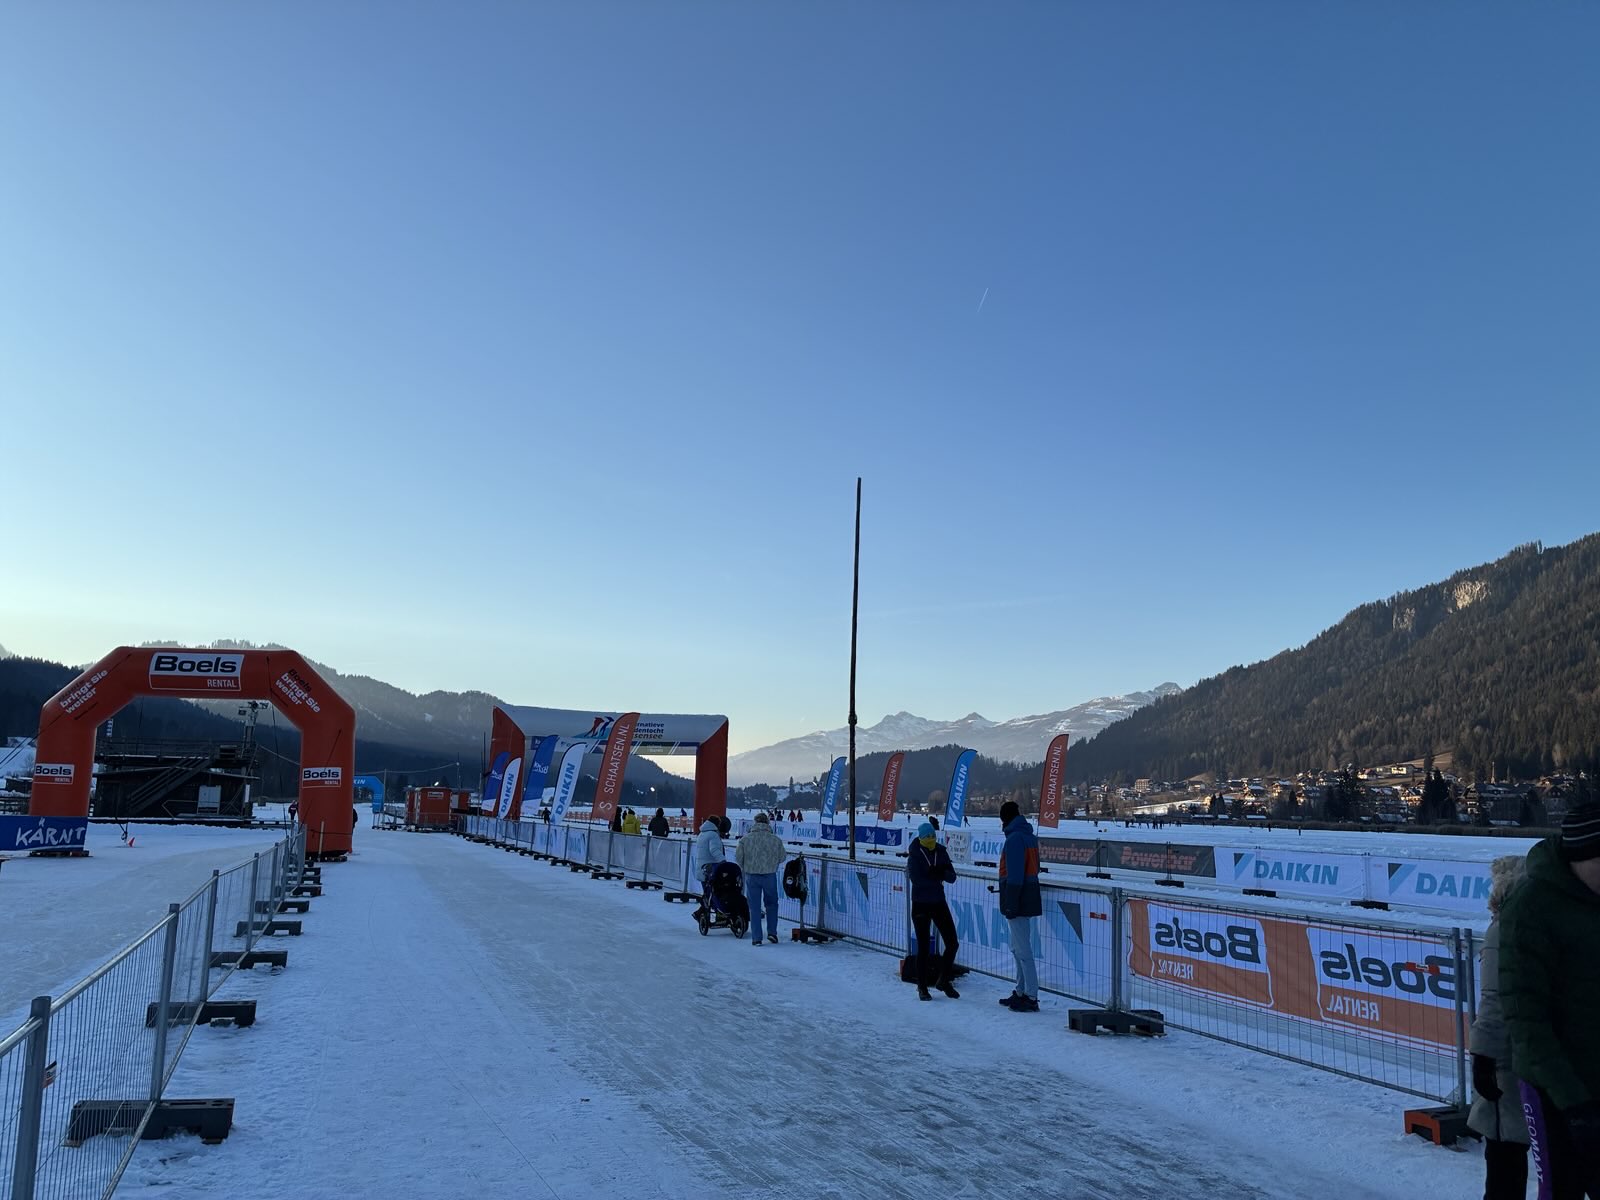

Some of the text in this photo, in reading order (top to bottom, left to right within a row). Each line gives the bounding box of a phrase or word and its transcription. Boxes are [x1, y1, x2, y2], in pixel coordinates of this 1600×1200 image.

[154, 655, 237, 673] Boels
[60, 682, 92, 708] bringt
[91, 670, 108, 684] Sie
[207, 678, 237, 688] RENTAL
[276, 679, 302, 705] weiter
[281, 672, 320, 713] bringt Sie
[65, 687, 97, 714] weiter
[35, 765, 72, 776] Boels
[603, 723, 630, 794] SCHAATSEN.NL
[303, 769, 340, 779] Boels
[827, 769, 840, 806] DAIKIN
[885, 760, 899, 805] SCHAATSEN.NL
[952, 763, 968, 811] DAIKIN
[1046, 745, 1062, 806] SCHAATSEN.NL
[500, 773, 515, 813] DAIKIN
[555, 763, 576, 816] DAIKIN
[972, 841, 1004, 856] DAIK
[1039, 844, 1094, 862] owerbar
[1120, 846, 1197, 871] Powerbar
[1253, 859, 1339, 886] DAIKIN
[1415, 872, 1494, 900] DAIK
